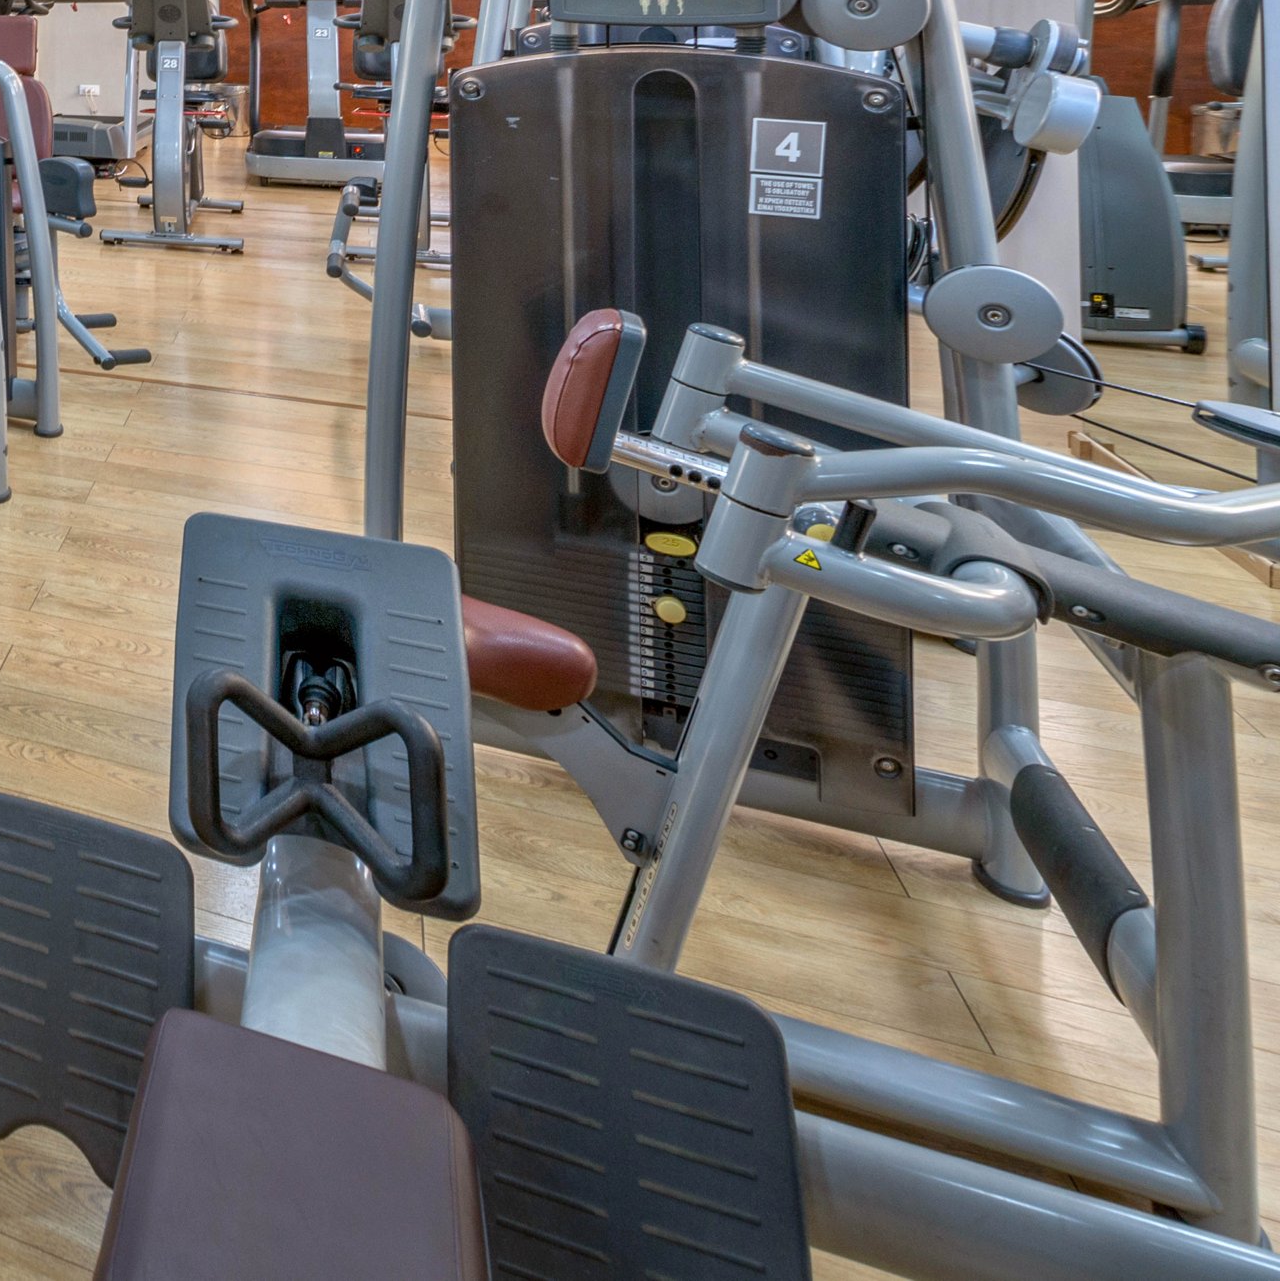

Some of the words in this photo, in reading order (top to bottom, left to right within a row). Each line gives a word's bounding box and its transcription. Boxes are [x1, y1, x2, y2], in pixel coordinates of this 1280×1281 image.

[315, 28, 328, 36] 23
[163, 59, 178, 69] 28
[775, 132, 801, 163] 4
[794, 182, 815, 190] TOWEL
[772, 188, 810, 196] OBLIGATORY
